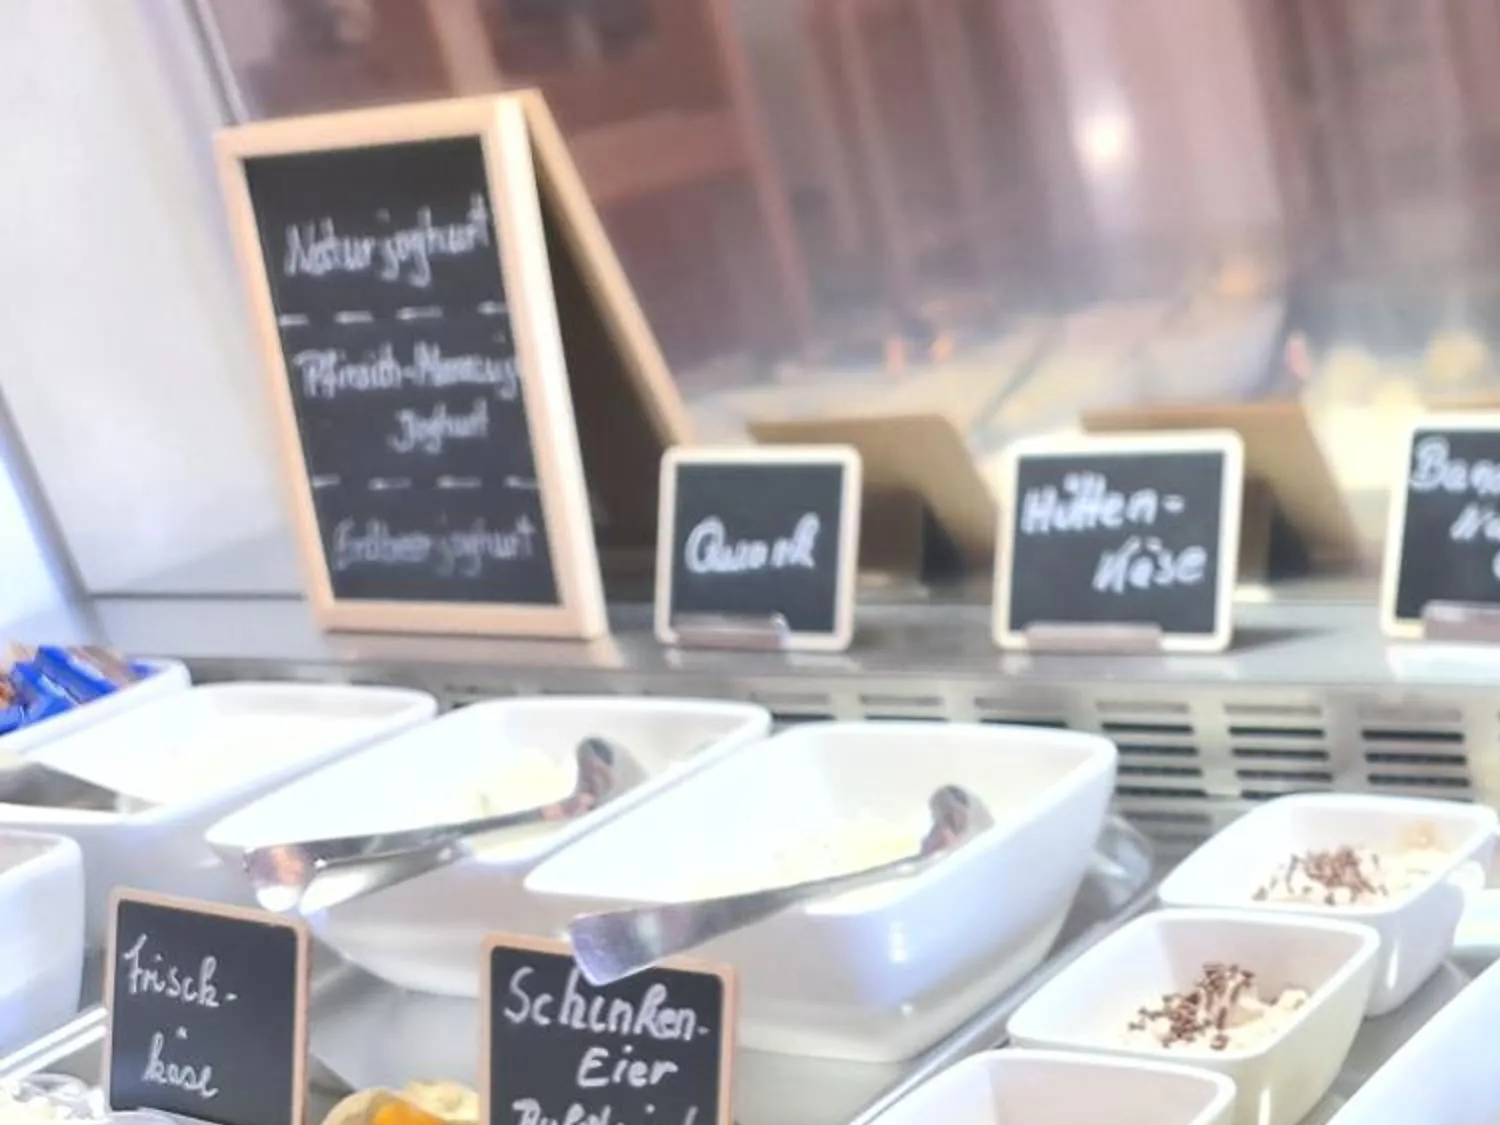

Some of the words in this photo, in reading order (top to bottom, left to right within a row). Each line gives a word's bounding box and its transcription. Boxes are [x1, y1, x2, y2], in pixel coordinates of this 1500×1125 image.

[1020, 471, 1186, 535] Hütten-
[684, 511, 821, 574] Quark
[575, 1045, 680, 1088] Eier
